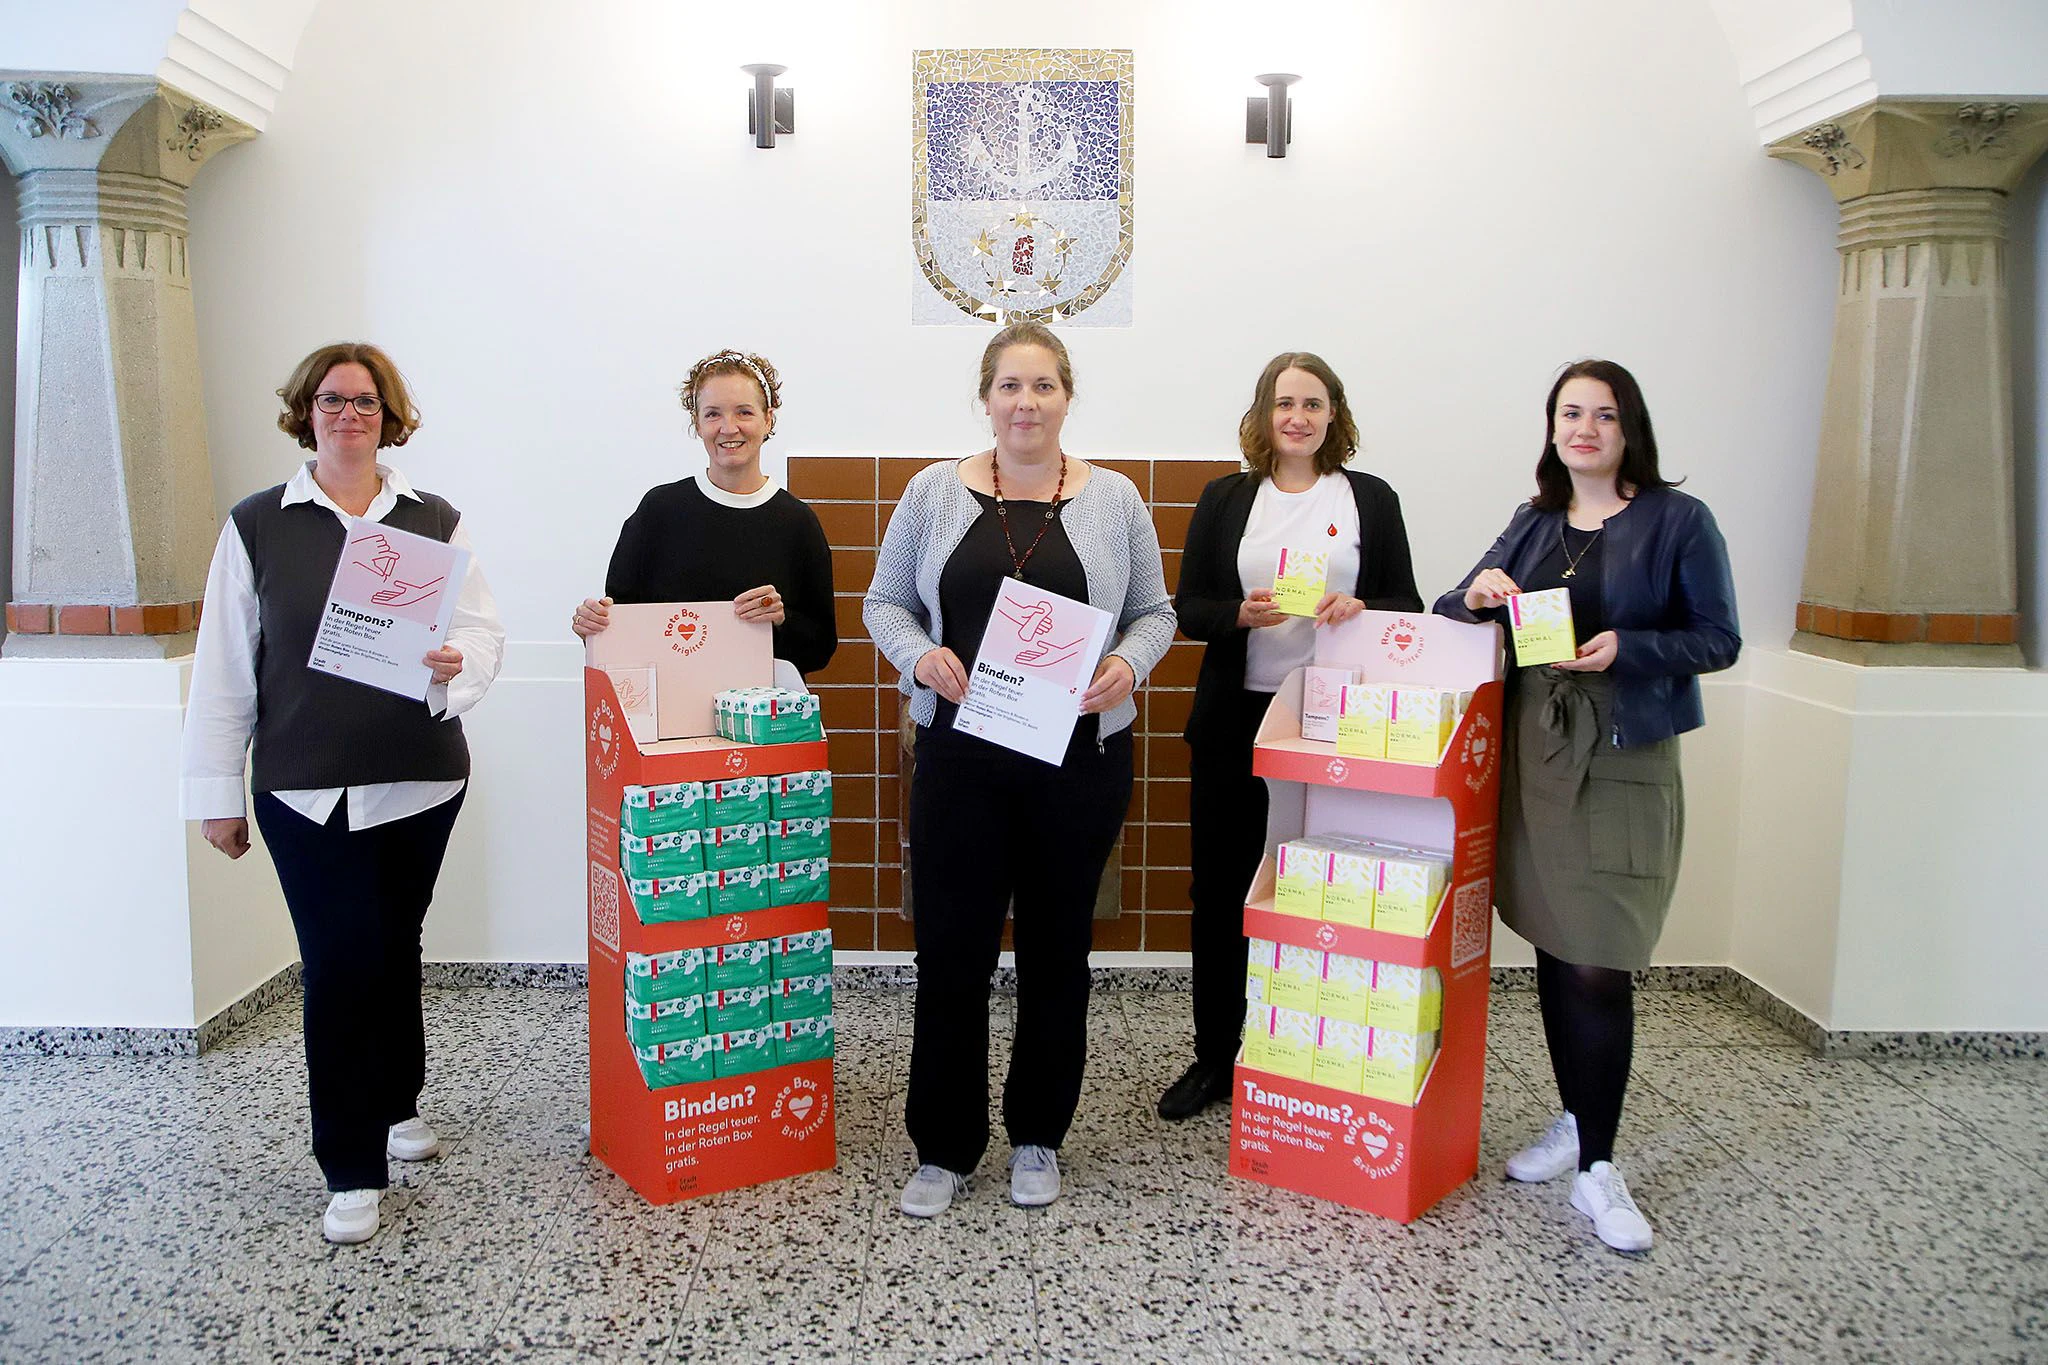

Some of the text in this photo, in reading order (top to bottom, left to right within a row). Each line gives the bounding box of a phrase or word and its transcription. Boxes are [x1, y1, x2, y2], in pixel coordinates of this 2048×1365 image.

[331, 602, 394, 628] Tampons?
[346, 620, 364, 631] Regel
[664, 608, 700, 636] Rote Box
[332, 623, 342, 631] der
[344, 627, 362, 638] Roten
[364, 632, 376, 640] Box
[672, 624, 707, 656] Brigittenau
[1381, 618, 1416, 644] Rote Box
[1388, 636, 1424, 667] Brigittenau
[977, 662, 1024, 686] Binden?
[989, 687, 1006, 698] Roten
[590, 698, 614, 741] Rote Box
[595, 732, 620, 780] Brigittenau
[1461, 723, 1476, 764] Rote
[664, 1084, 756, 1122] Binden?
[770, 1076, 818, 1119] Rote Box
[1243, 1080, 1354, 1126] Tampons?
[664, 1114, 760, 1142] In der Regel teuer.
[781, 1093, 829, 1141] Brigittenau
[1242, 1108, 1334, 1141] In der Regel teuer.
[1344, 1112, 1396, 1146] Rote Box
[665, 1129, 753, 1156] In der Roten Box
[1240, 1138, 1272, 1154] gratis.
[1241, 1122, 1325, 1152] In der Roten Box
[665, 1155, 700, 1174] gratis.
[1352, 1142, 1404, 1180] Brigittenau
